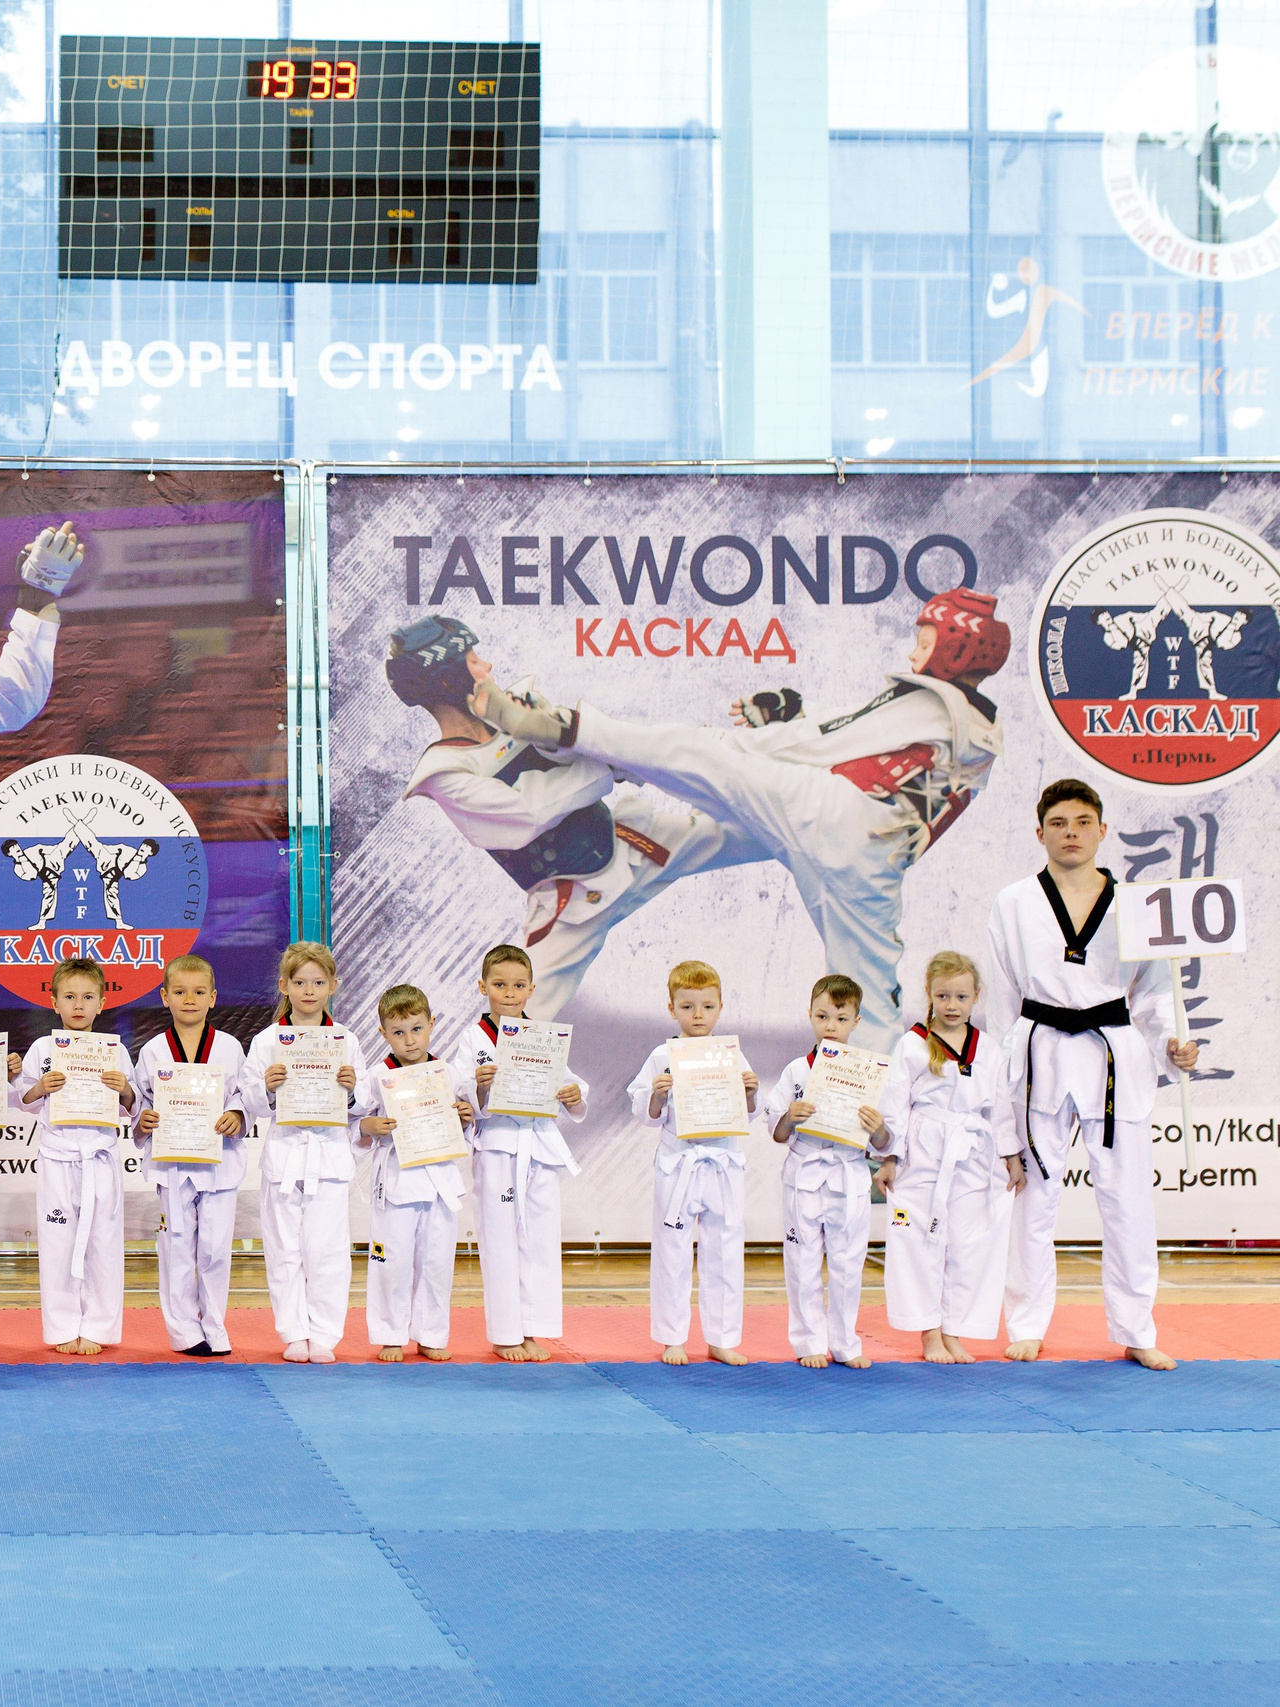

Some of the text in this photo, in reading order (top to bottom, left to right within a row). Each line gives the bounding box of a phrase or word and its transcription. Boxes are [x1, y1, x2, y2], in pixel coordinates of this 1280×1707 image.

[458, 81, 496, 96] СЧЕТ
[56, 340, 562, 397] ДВОРЕЦ СПОРТА
[1082, 368, 1270, 396] ПЕРМСКИЕ
[393, 533, 979, 606] TAEKWONDO
[1106, 557, 1239, 594] TAEKWONDO
[1046, 528, 1266, 696] ШКОЛА ПЛАСТИКИ И БОЕВЫХ
[575, 617, 796, 664] КАСКАД
[1083, 704, 1260, 741] КАСКАД
[1132, 750, 1217, 768] г.Пермь
[16, 790, 147, 827] TAEKWONDO
[70, 762, 82, 776] И
[93, 762, 170, 812] БОЕВЫХ
[169, 815, 202, 922] ИСКУССТВ
[1145, 883, 1238, 947] 10
[66, 1065, 105, 1074] СЕРТИФИКАТ
[511, 1055, 552, 1065] СЕРТИФИКАТ
[825, 1076, 866, 1090] СЕРТИФИКАТ
[501, 1194, 513, 1203] Dae
[46, 1214, 67, 1225] Daedo
